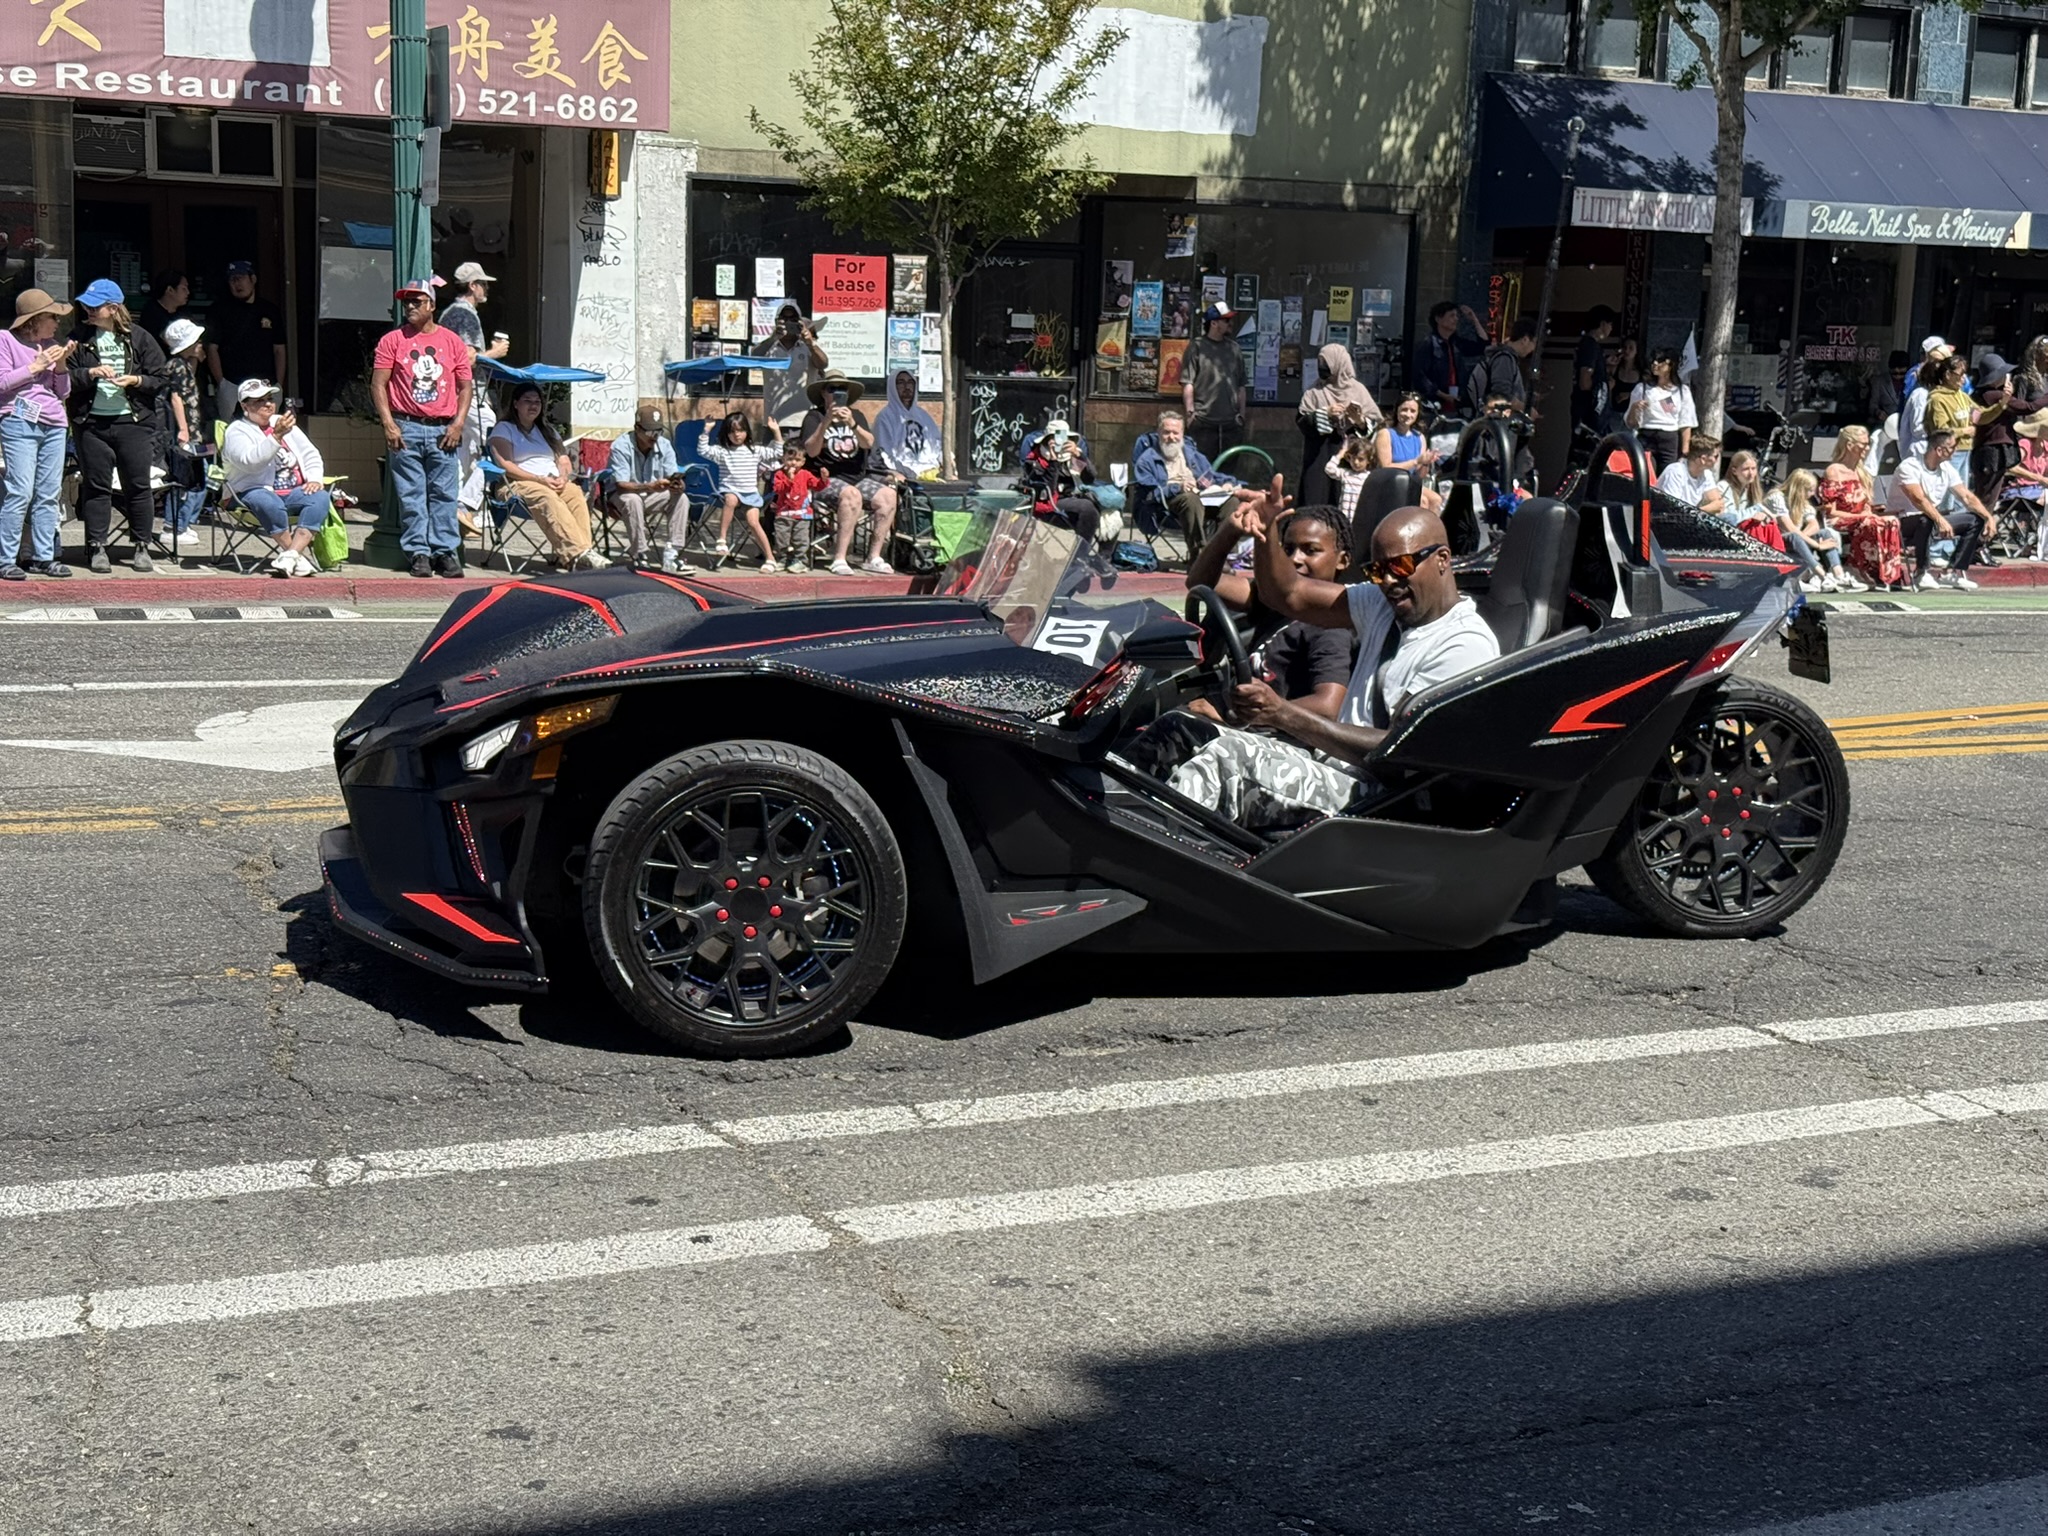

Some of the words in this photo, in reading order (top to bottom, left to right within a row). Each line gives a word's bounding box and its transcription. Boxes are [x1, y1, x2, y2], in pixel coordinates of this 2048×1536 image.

[56, 62, 343, 106] Restaurant
[478, 88, 638, 123] 521-6862
[603, 138, 615, 188] ARK
[1579, 196, 1634, 224] LITTLE
[1811, 205, 1859, 234] Bella
[1860, 208, 1902, 237] Nail
[1903, 213, 1932, 242] Spa
[1936, 213, 1951, 239] &
[1952, 214, 2007, 248] Waxing
[835, 258, 866, 274] For
[823, 275, 876, 293] Lease
[817, 296, 882, 308] 415.395.7262
[1332, 289, 1350, 298] IMP
[842, 320, 861, 329] Choi
[1826, 325, 1858, 345] TK
[831, 341, 876, 350] Badstubner
[1804, 344, 1836, 361] BARBER
[1836, 345, 1858, 361] SHOP
